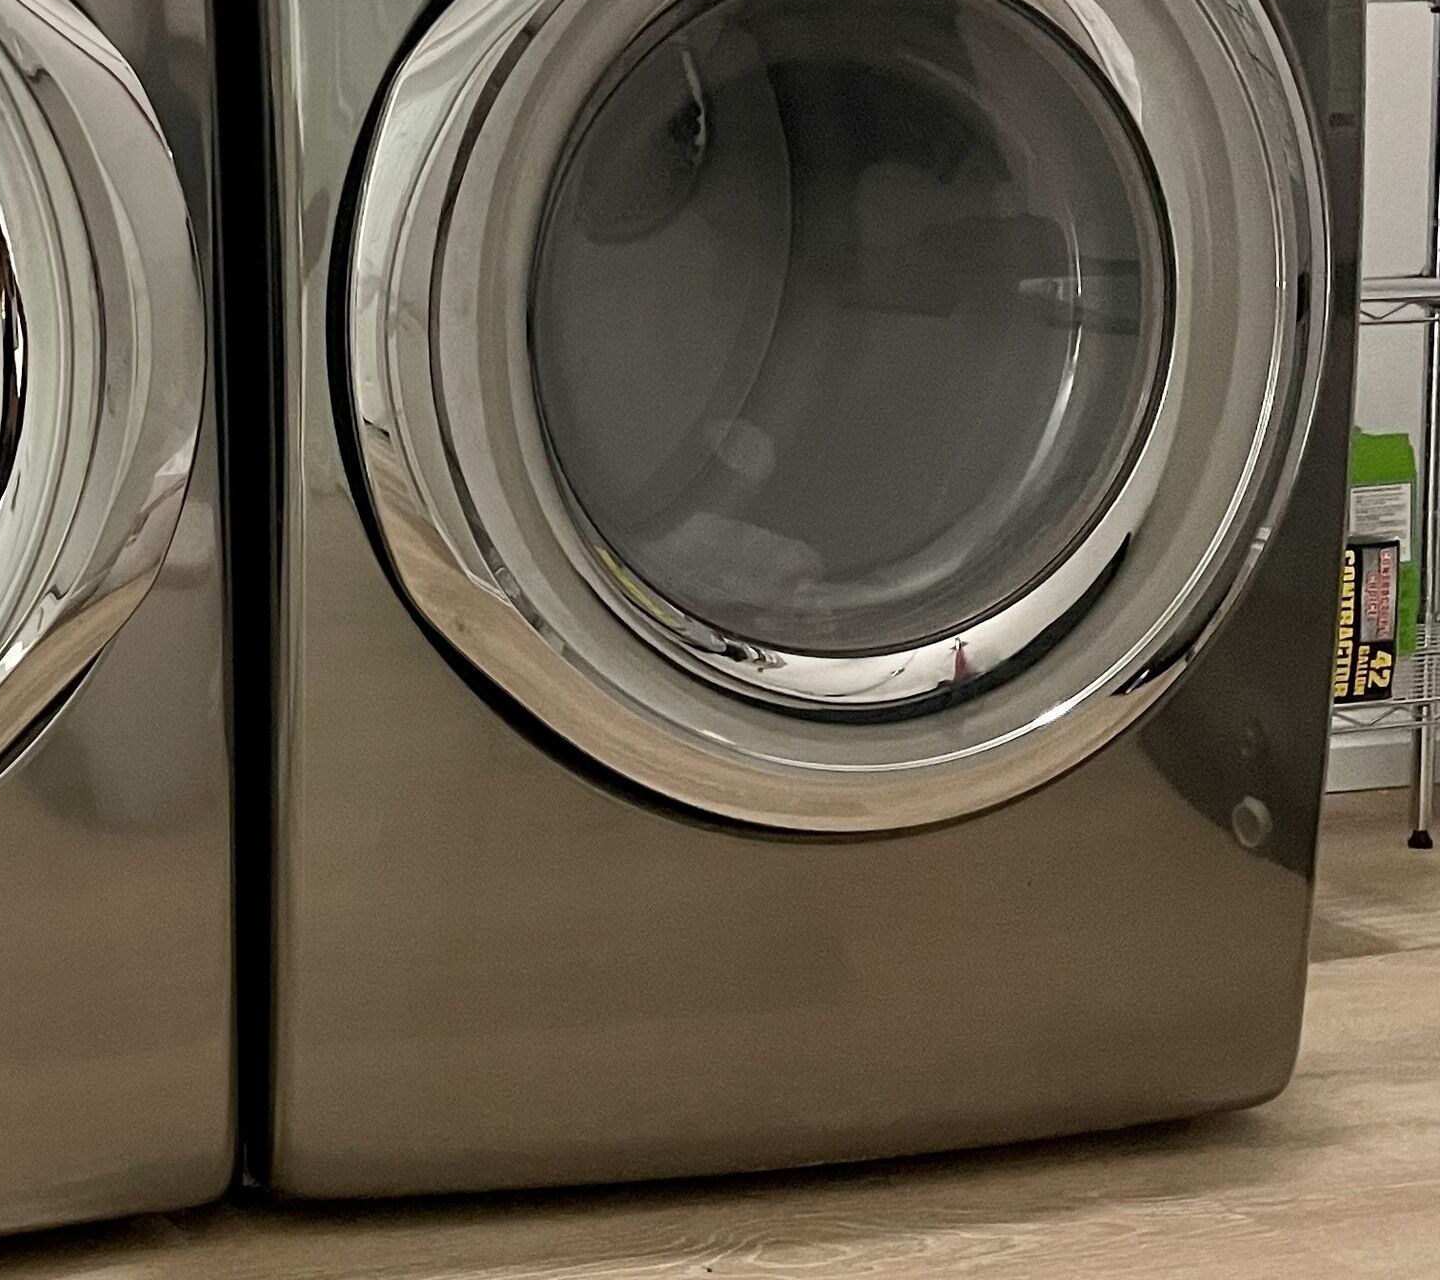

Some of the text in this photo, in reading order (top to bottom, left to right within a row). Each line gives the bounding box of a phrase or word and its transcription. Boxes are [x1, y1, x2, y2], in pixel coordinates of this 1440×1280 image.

[1333, 549, 1355, 698] CONTRACTOR
[1353, 645, 1370, 696] GALLON
[1367, 651, 1392, 688] 42
